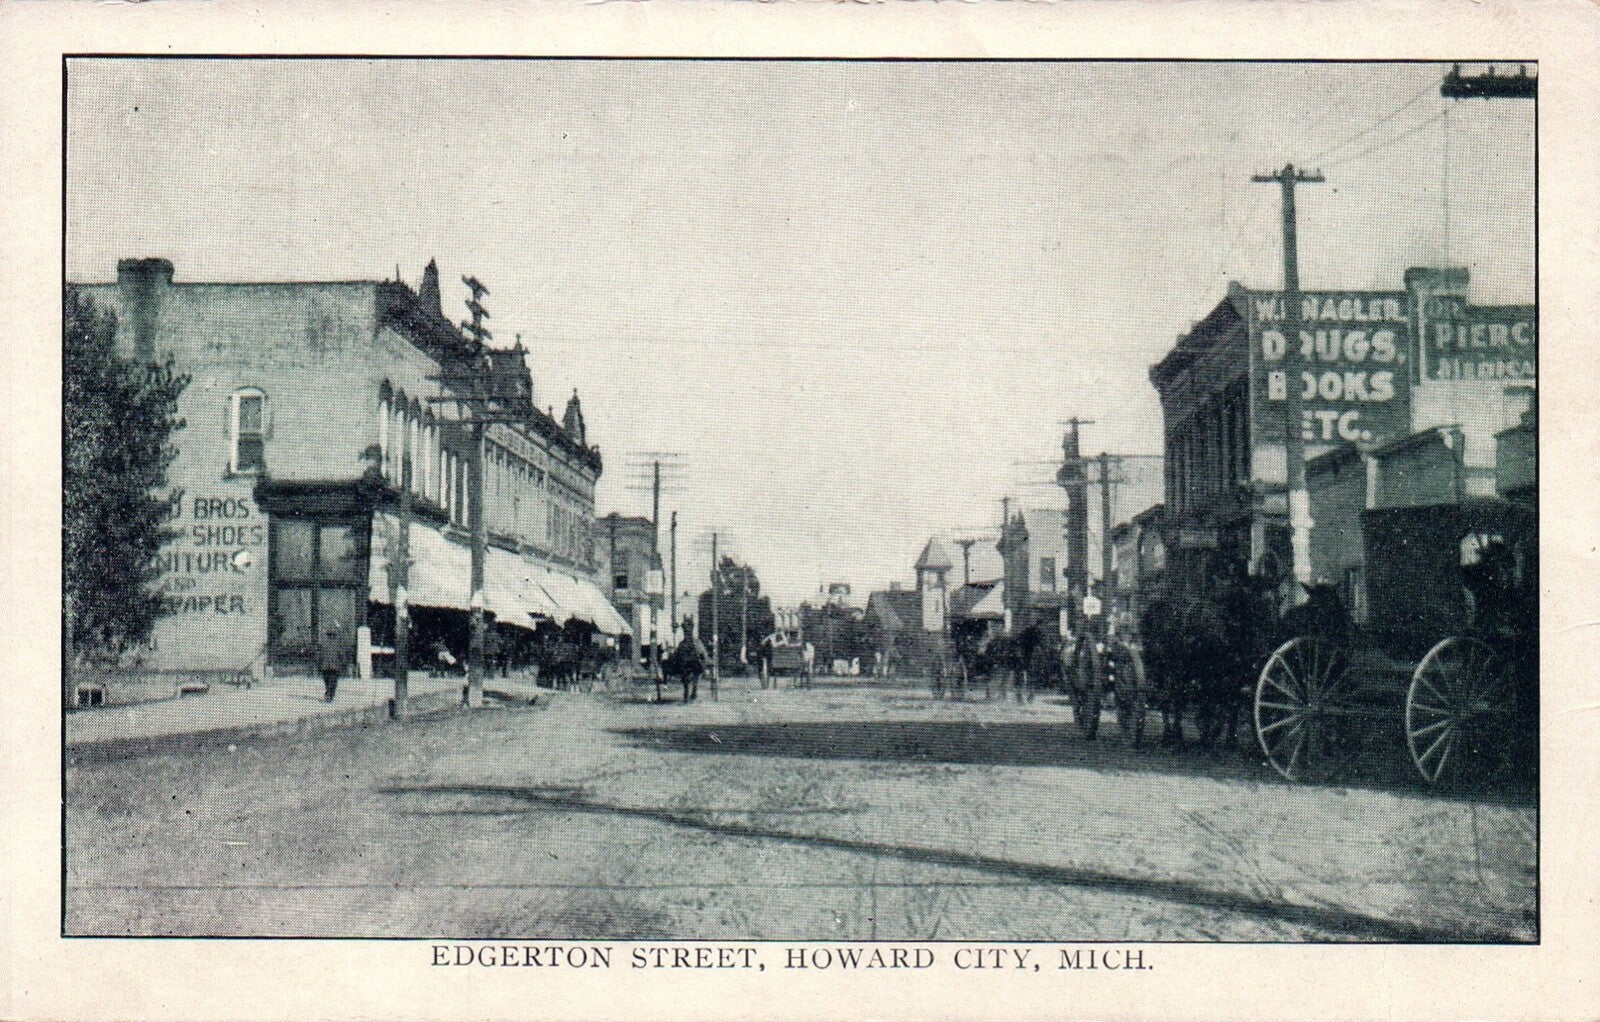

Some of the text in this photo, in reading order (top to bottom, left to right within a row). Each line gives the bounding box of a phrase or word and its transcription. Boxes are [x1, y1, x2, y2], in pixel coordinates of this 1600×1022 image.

[1269, 370, 1396, 402] BOOKS
[1302, 409, 1372, 442] ETC.
[192, 525, 264, 547] SHOES
